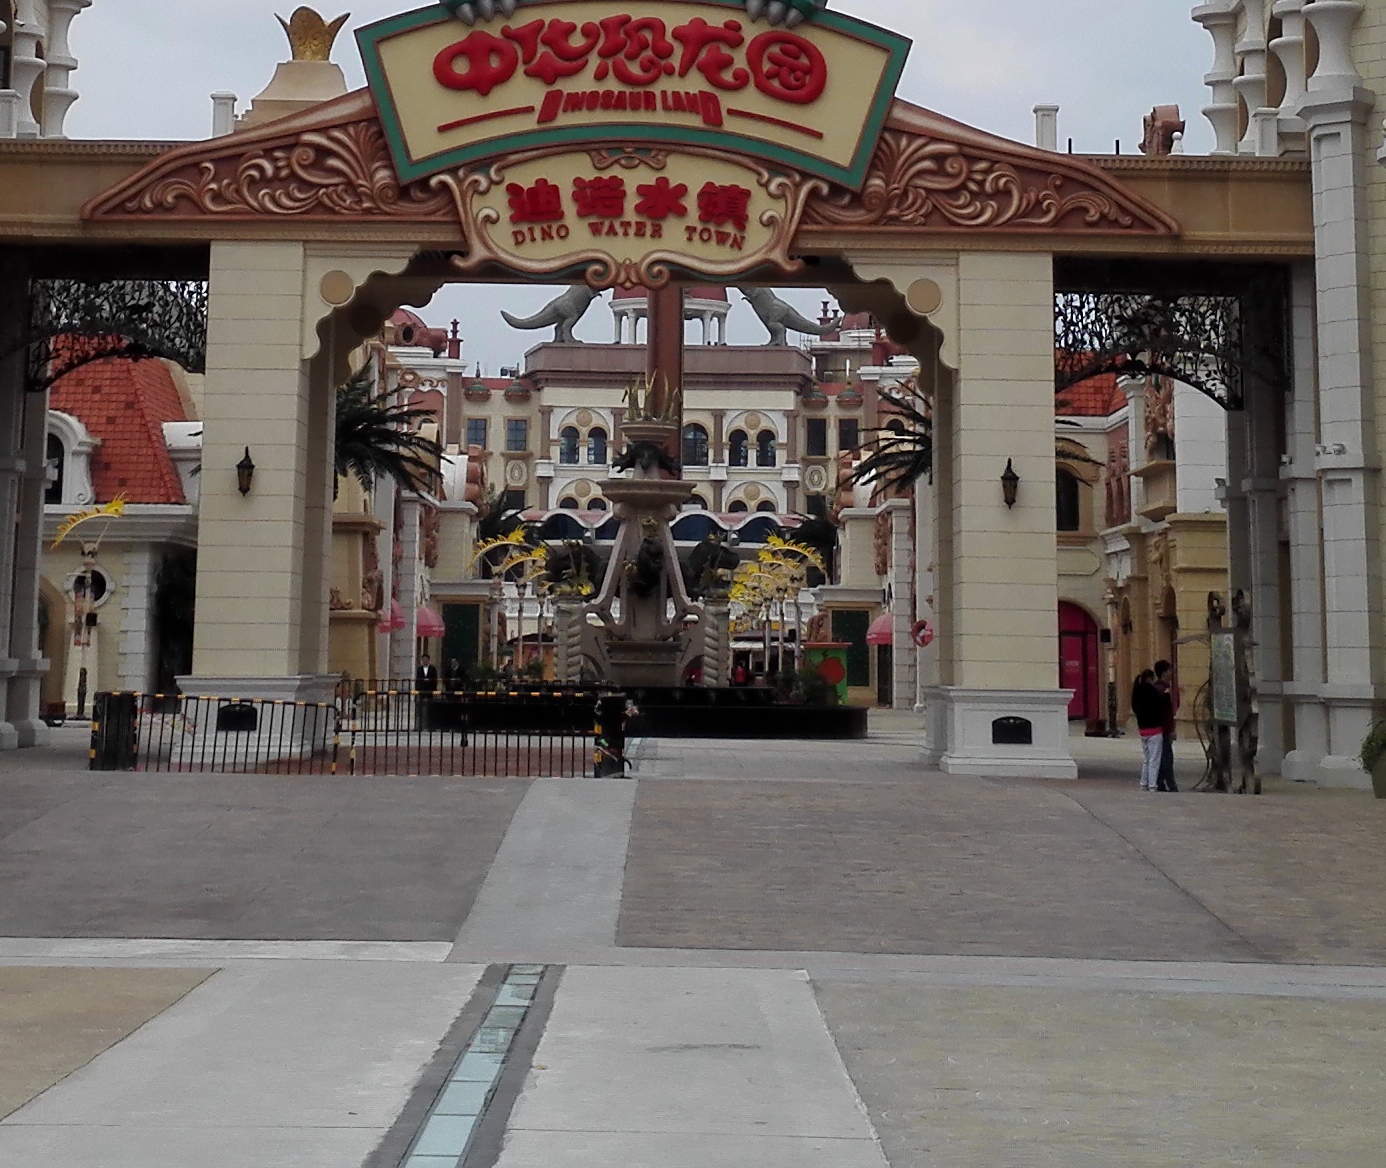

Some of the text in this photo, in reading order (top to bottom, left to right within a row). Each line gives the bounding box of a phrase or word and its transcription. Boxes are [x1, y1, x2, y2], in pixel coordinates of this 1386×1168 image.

[432, 13, 827, 104] 中华恐龙园
[537, 88, 724, 126] DINOSAUR LAND
[506, 175, 753, 230] 迪诺水镇
[513, 220, 745, 249] DINO WATER TOWN
